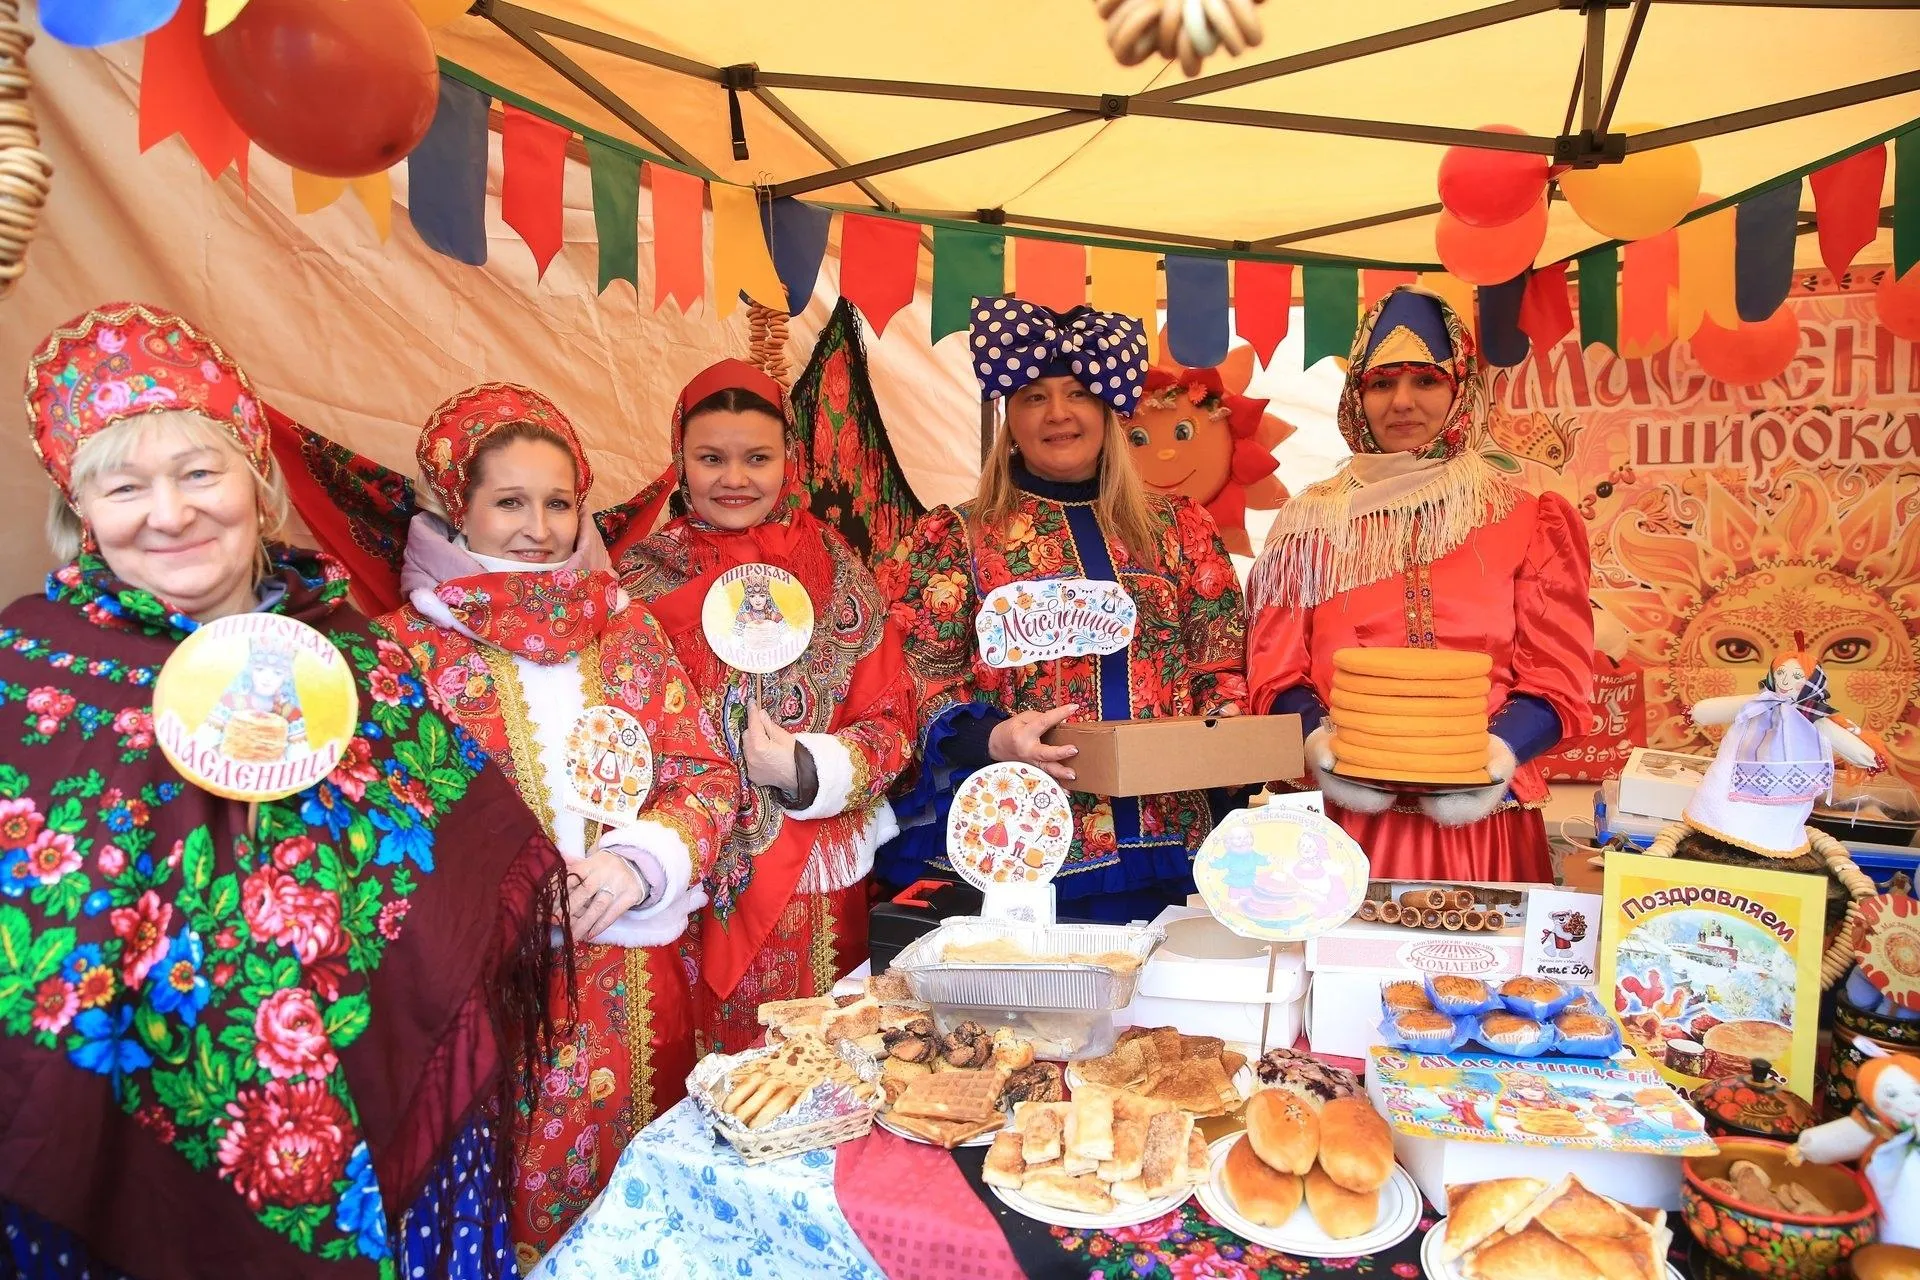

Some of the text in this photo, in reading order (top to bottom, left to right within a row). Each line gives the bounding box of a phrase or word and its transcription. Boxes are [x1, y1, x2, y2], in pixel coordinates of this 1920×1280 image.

[721, 564, 791, 586] ШИРОКАЯ
[212, 615, 336, 665] ШИРОКАЯ
[988, 599, 1124, 655] Масленица
[159, 714, 337, 791] МАСЛЕНИЦА
[1621, 886, 1796, 943] Поздравляем
[1376, 1054, 1409, 1071] С
